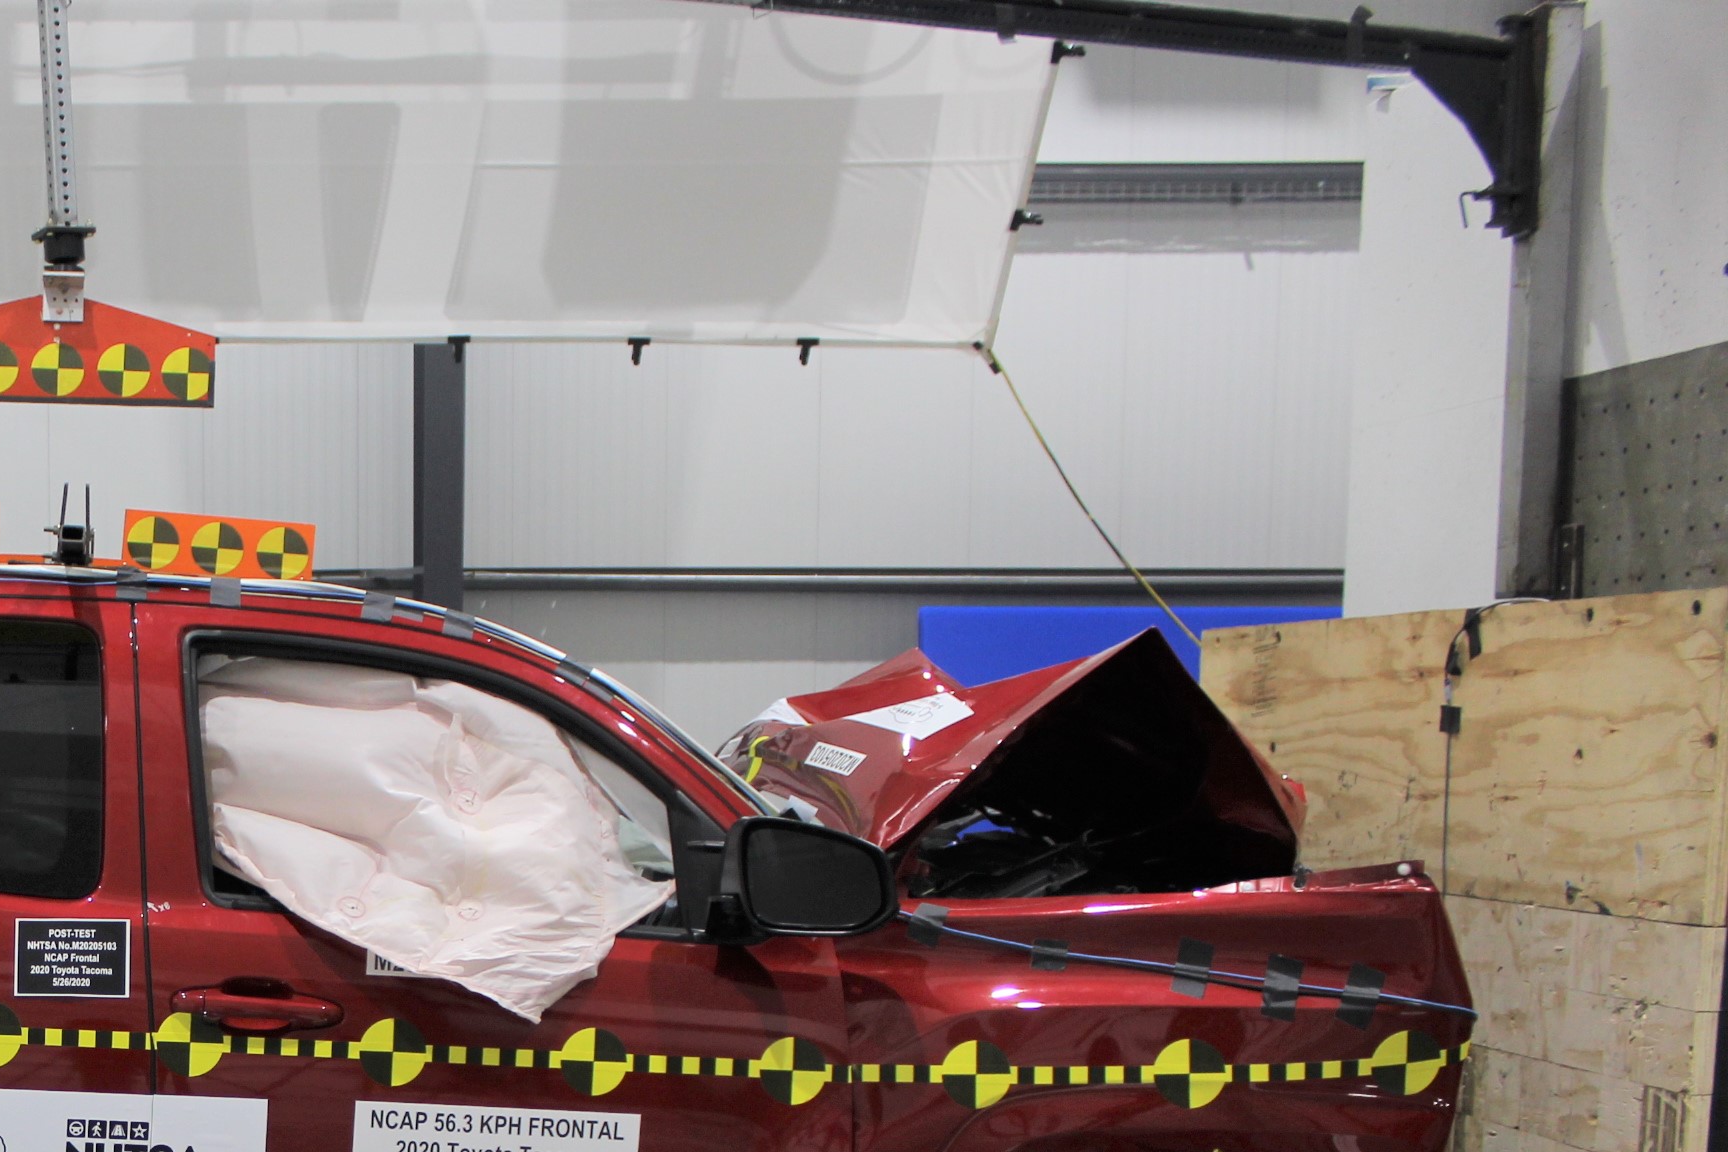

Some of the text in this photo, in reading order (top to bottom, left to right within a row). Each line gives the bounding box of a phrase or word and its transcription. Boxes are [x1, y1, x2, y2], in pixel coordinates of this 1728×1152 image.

[48, 928, 96, 939] POST-TEST
[27, 940, 117, 951] NHTSA No.M20205103
[44, 952, 100, 963] NCAP Frontal
[30, 965, 113, 976] 2020 Toyota Tacoma
[52, 977, 91, 987] 5/26/2020
[370, 1109, 625, 1141] NCAP 56.3 KPH FRONTAL
